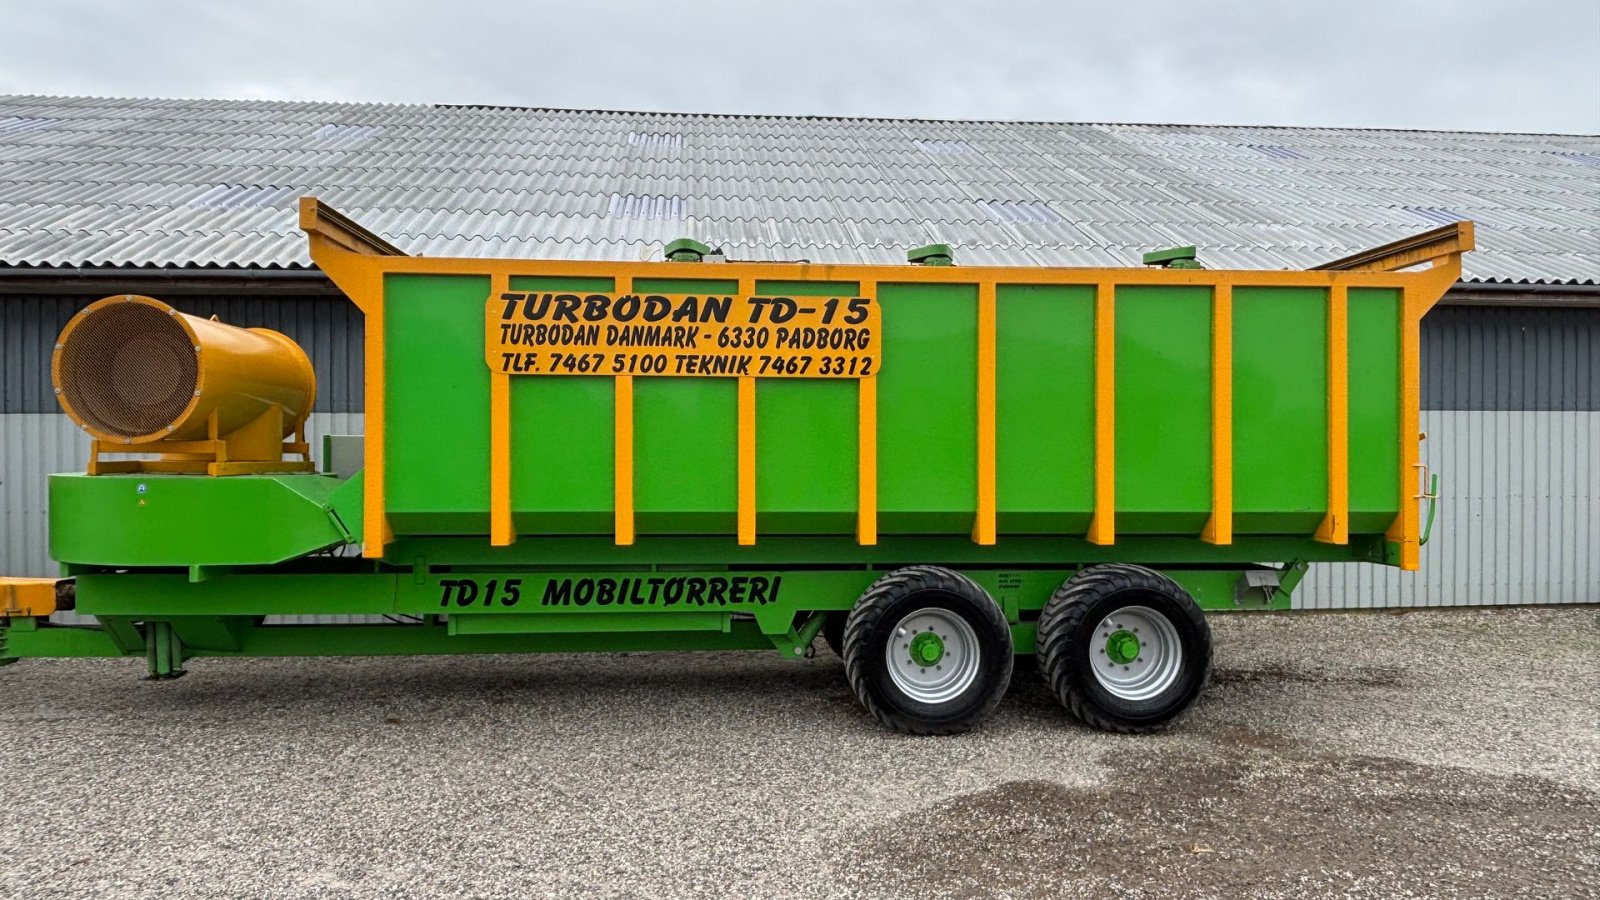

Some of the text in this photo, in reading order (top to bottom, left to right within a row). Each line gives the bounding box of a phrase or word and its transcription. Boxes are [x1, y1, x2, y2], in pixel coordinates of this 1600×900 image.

[500, 293, 871, 324] TURBODAN TD-15
[500, 324, 600, 346] TURBODAN
[606, 326, 700, 349] DANMARK
[717, 326, 769, 349] 6330
[775, 327, 871, 351] PADBORG
[501, 352, 873, 375] TLF. 7467 5100 TEKNIK 7467 3312
[439, 576, 782, 607] TD15 MOBILTØRRERI
